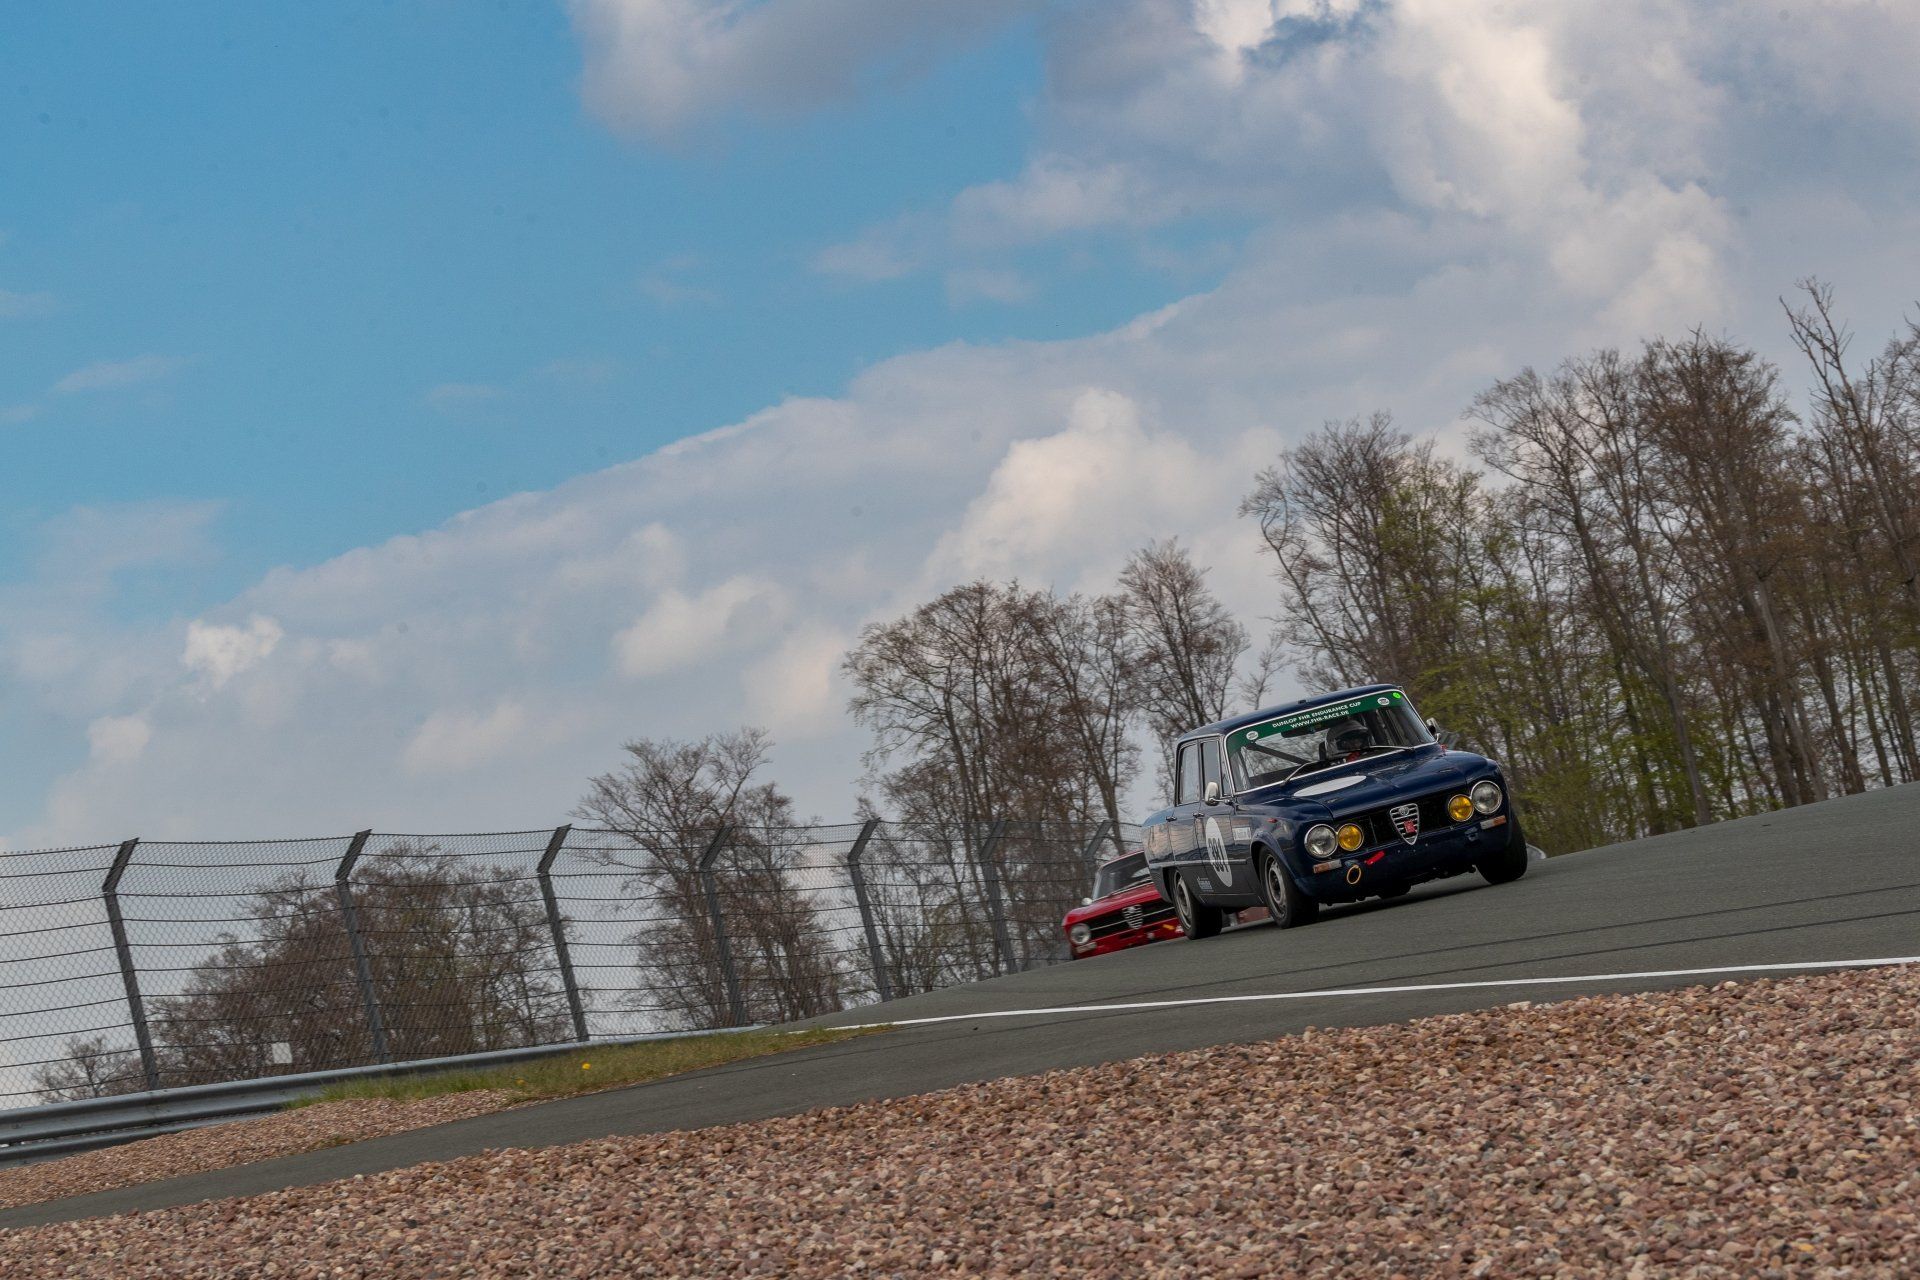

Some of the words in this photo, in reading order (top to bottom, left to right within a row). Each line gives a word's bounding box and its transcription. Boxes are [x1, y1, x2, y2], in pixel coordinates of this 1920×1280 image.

[1272, 717, 1297, 728] DUNLOP
[1298, 713, 1311, 721] FHR
[1311, 704, 1349, 717] ENDURANCE
[1290, 710, 1350, 729] WWW.FHR-RACE.DE
